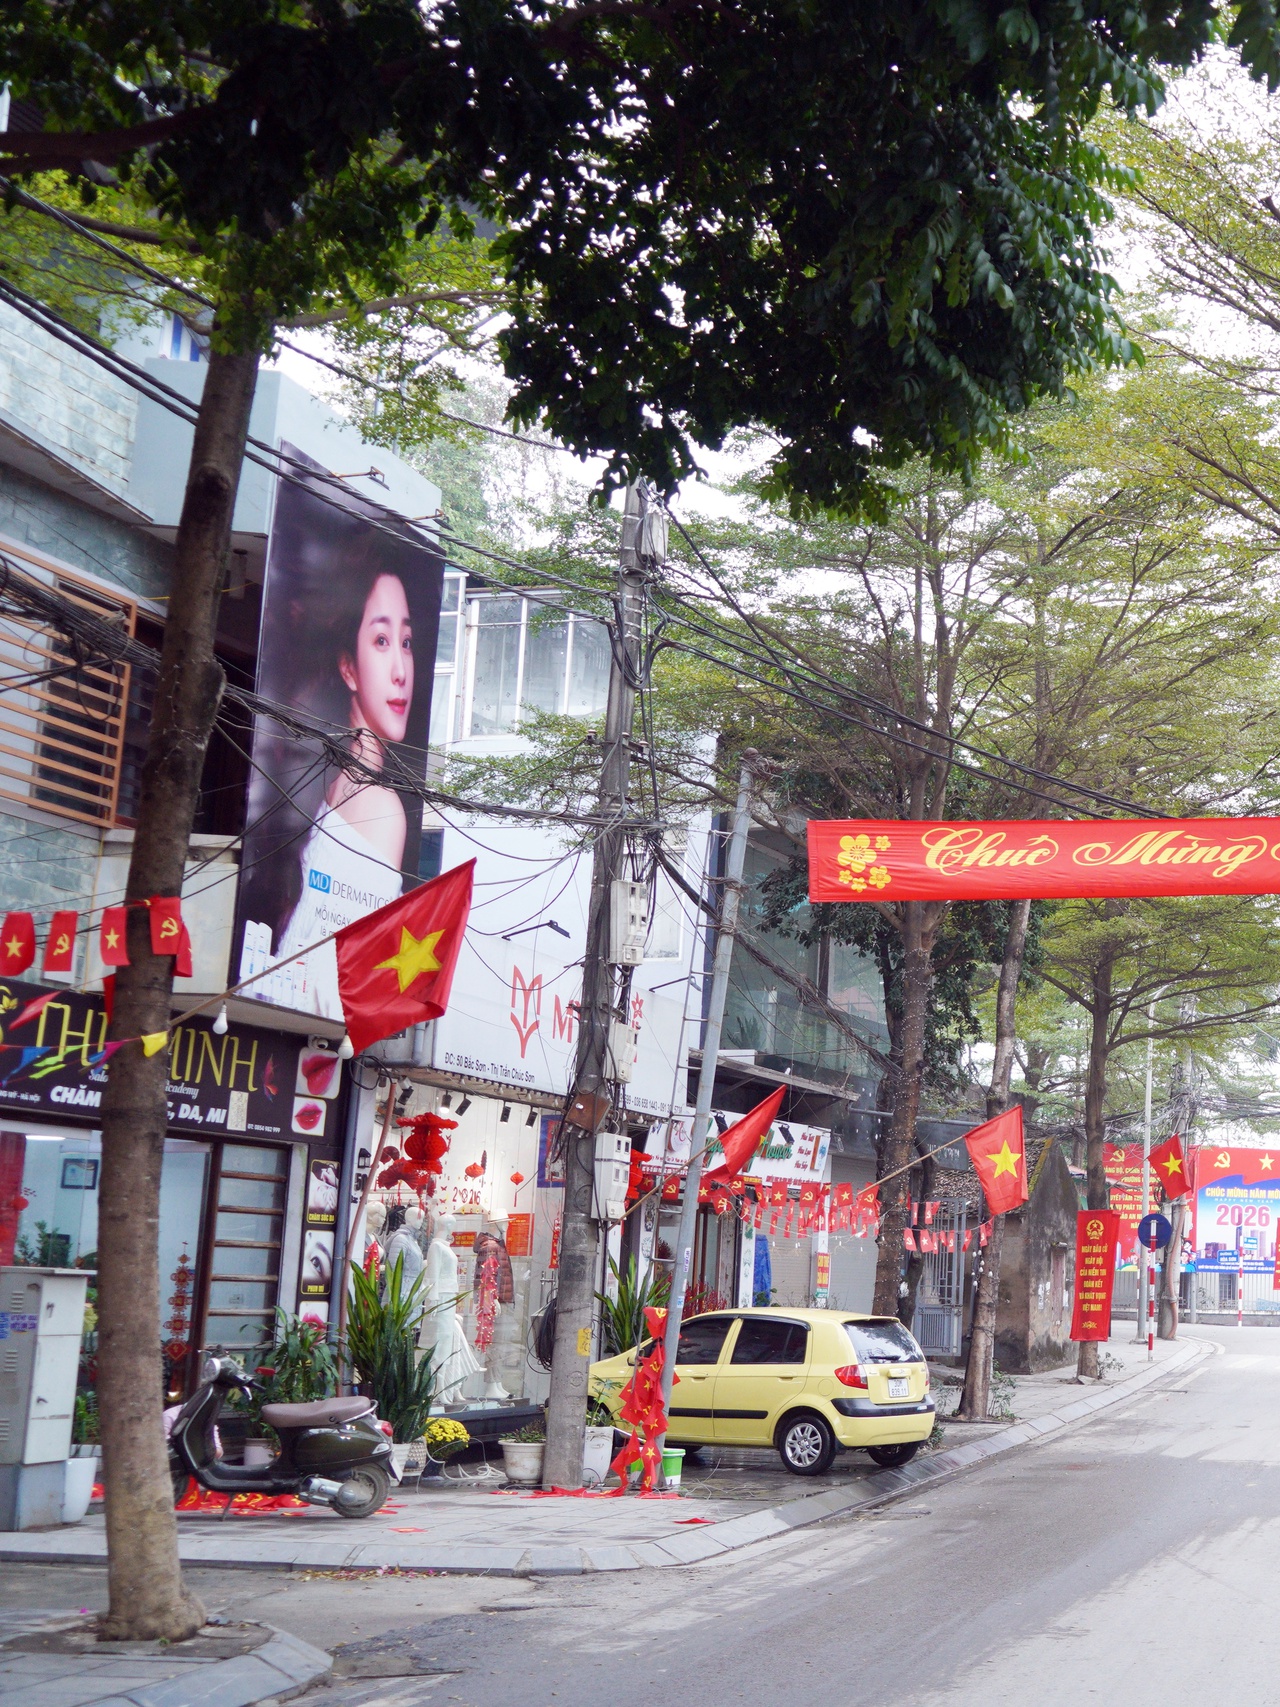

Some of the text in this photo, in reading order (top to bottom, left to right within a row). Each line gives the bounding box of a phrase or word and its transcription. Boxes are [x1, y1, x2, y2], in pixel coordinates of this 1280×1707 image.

[921, 827, 1059, 876] Chúc
[1072, 829, 1268, 878] Mừng
[310, 873, 329, 891] MD
[88, 1069, 109, 1083] Salo
[456, 1055, 464, 1067] 50
[464, 1055, 474, 1070] Bắc
[476, 1060, 486, 1072] Sơn
[525, 1071, 536, 1083] Sơn
[50, 1084, 102, 1108] CHĂM
[178, 1103, 203, 1124] DA,
[1216, 1204, 1270, 1228] 2026
